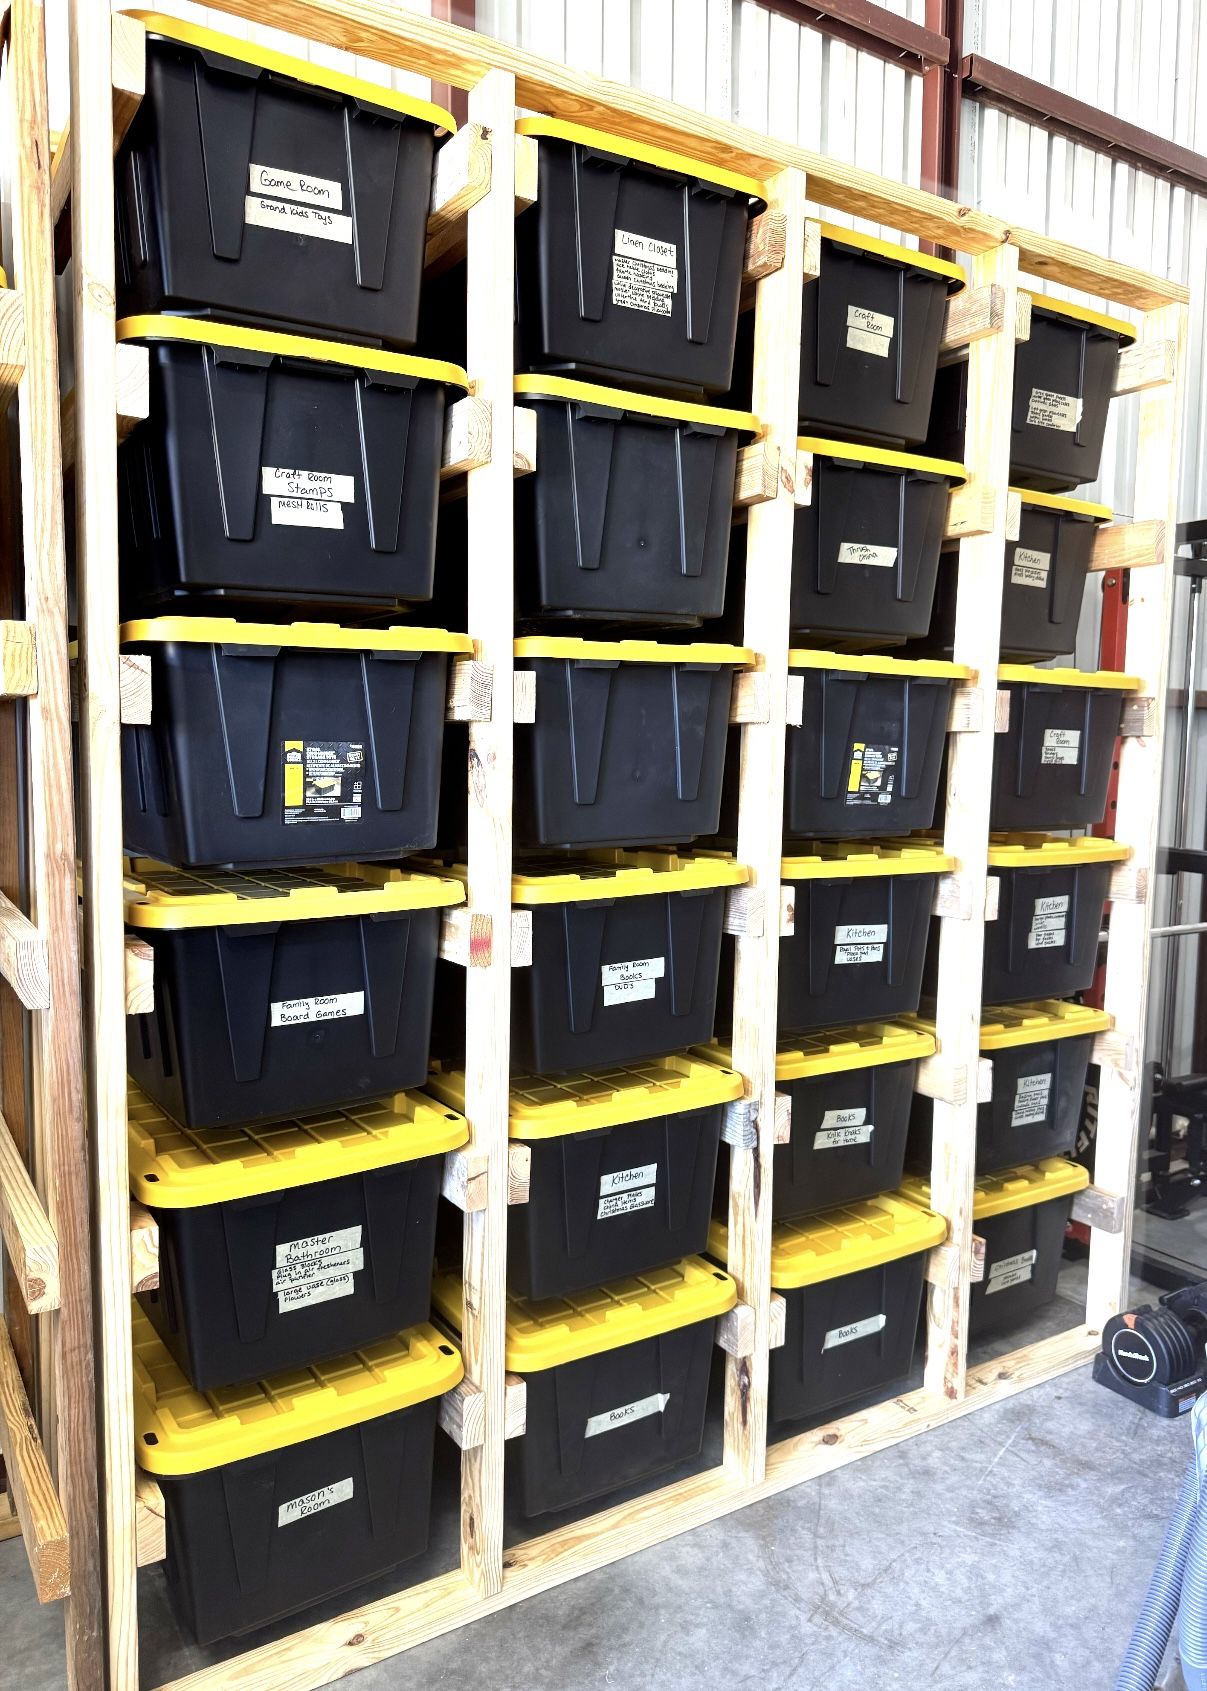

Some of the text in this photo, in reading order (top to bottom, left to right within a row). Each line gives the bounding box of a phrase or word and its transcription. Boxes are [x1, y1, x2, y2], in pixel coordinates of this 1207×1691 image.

[260, 170, 330, 198] Game Room
[312, 211, 333, 225] Toys
[622, 234, 674, 256] Linen Closet
[854, 309, 875, 321] Craft
[866, 321, 882, 331] Room
[275, 468, 332, 484] Craft Room
[846, 928, 876, 939] Kitchen
[608, 964, 629, 972] Family
[620, 973, 643, 981] Books
[282, 997, 338, 1010] Family Room
[280, 1009, 347, 1022] Board Games
[836, 1114, 856, 1122] Books
[611, 1170, 644, 1187] Kitchen
[285, 1245, 342, 1263] Bathroom
[838, 1326, 858, 1339] Books
[609, 1405, 636, 1421] Books
[300, 1498, 331, 1516] Room
